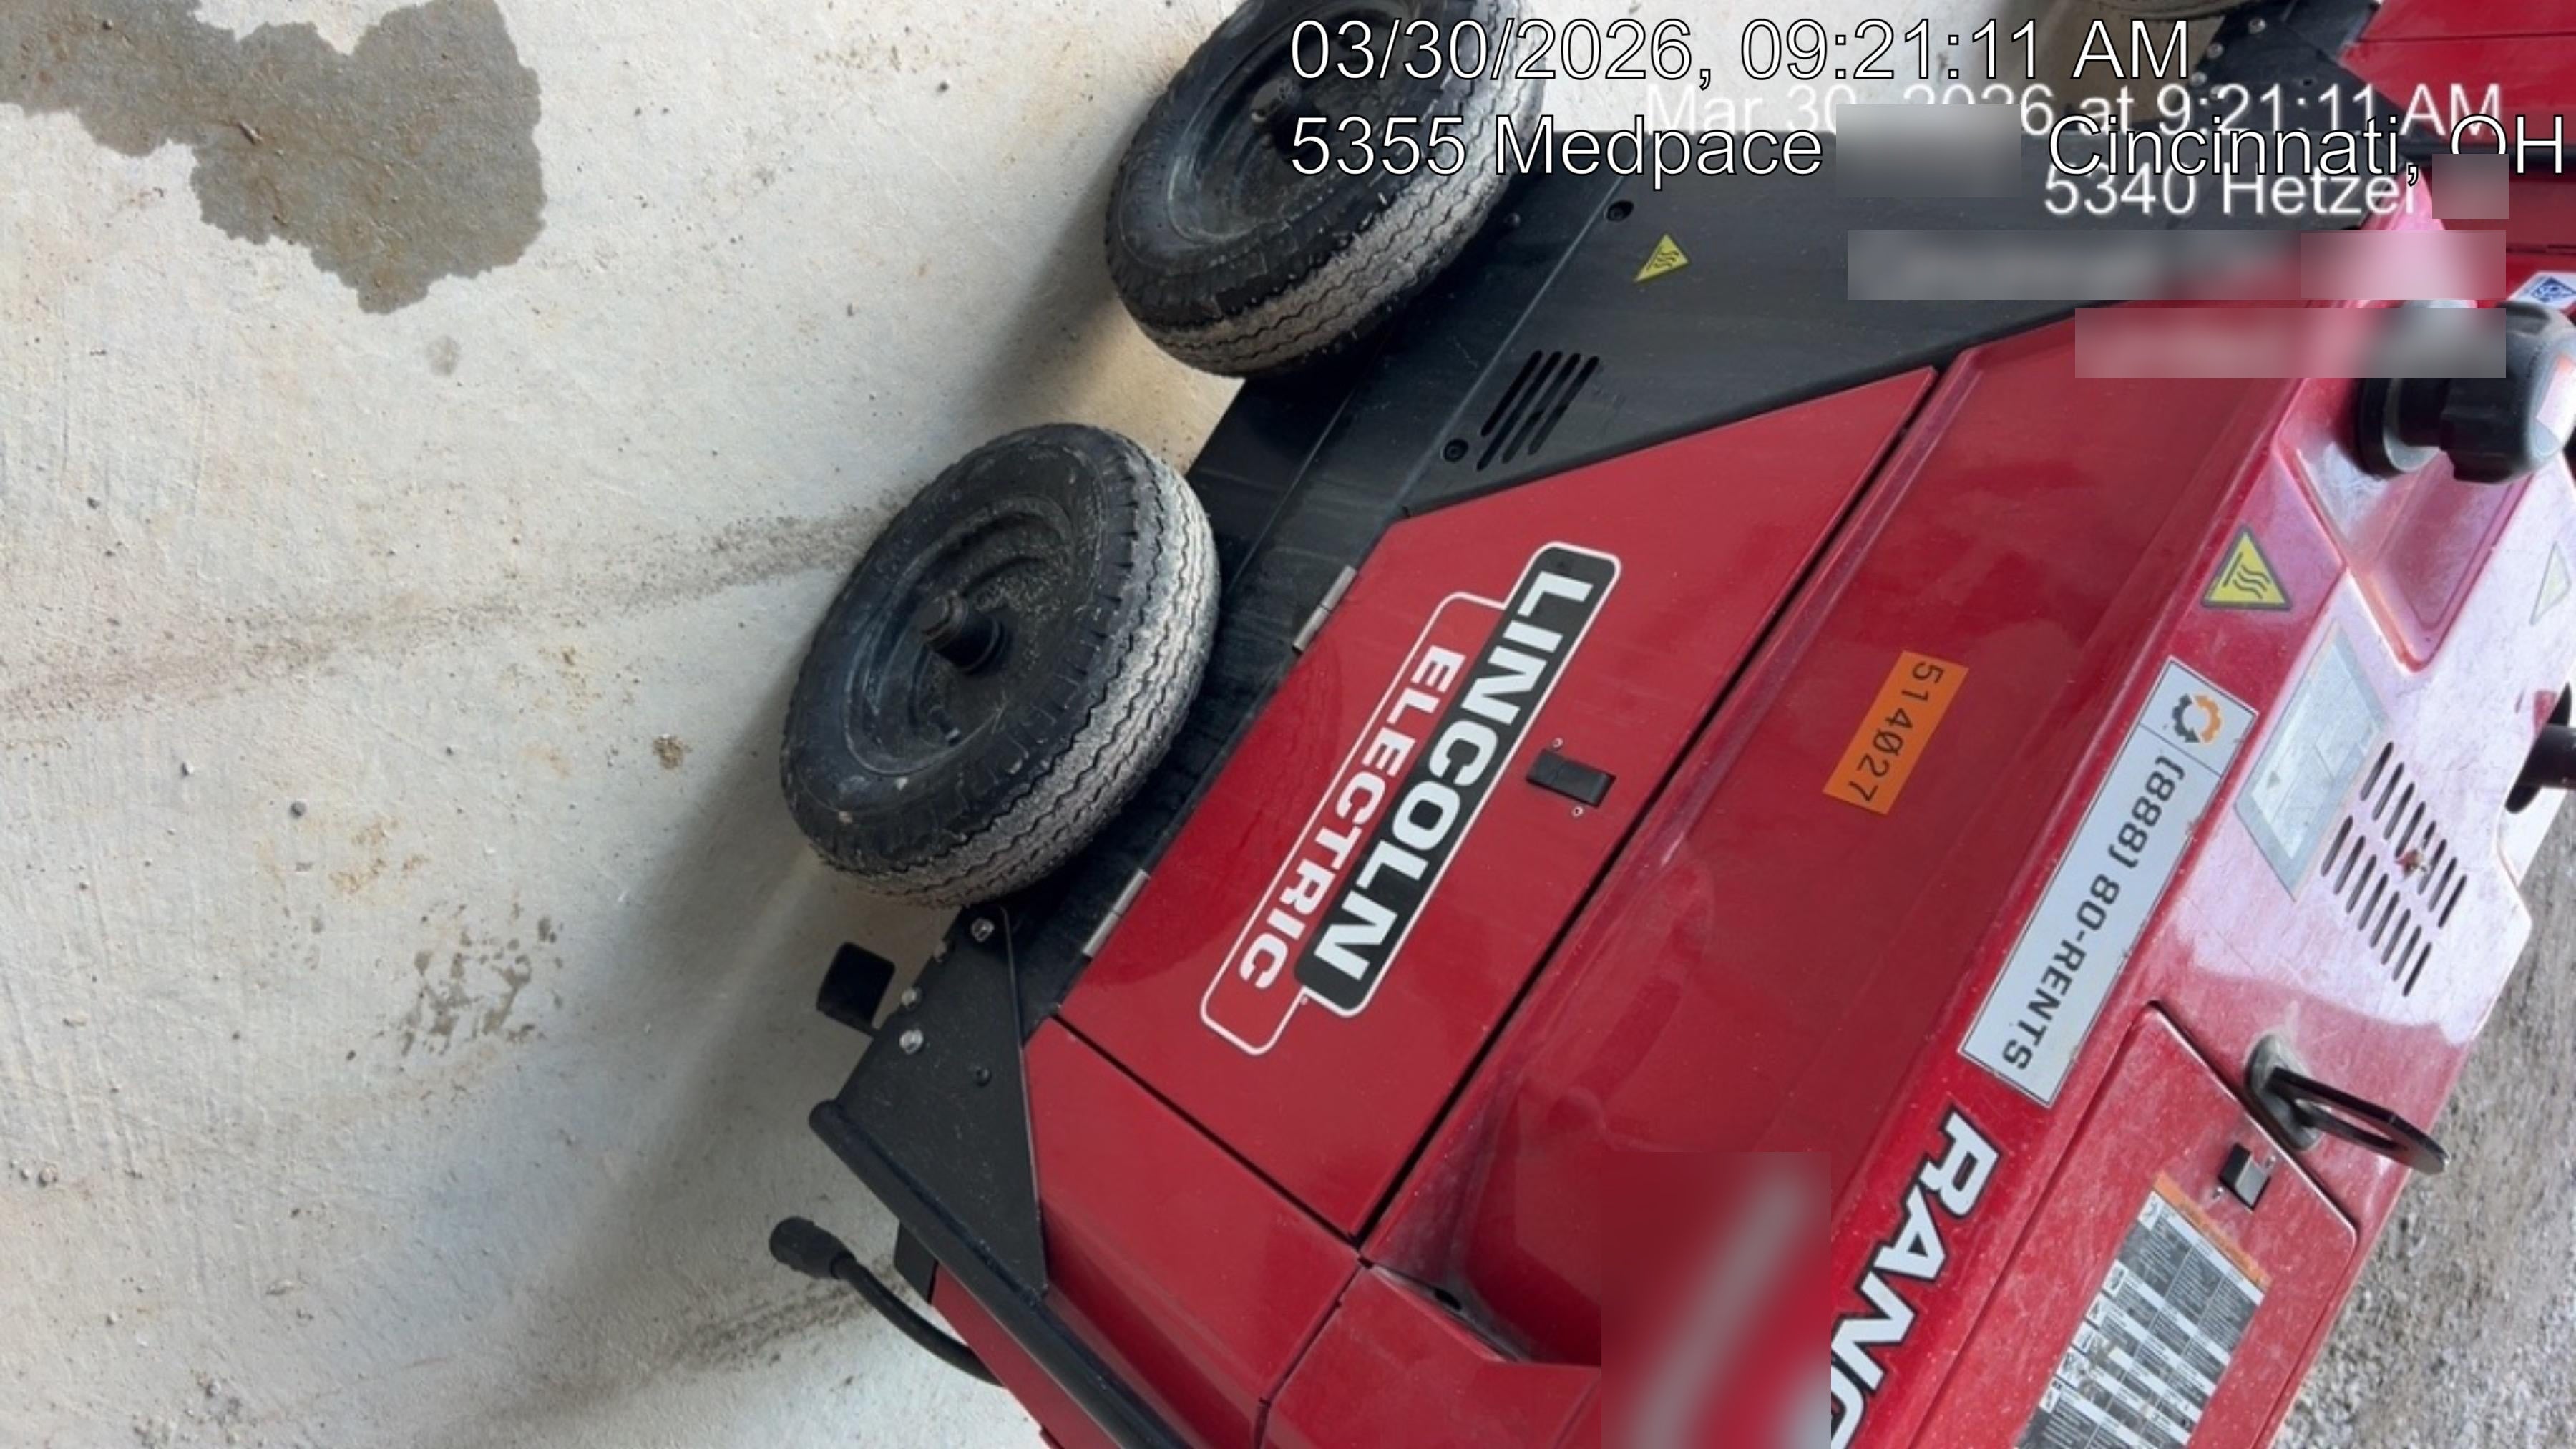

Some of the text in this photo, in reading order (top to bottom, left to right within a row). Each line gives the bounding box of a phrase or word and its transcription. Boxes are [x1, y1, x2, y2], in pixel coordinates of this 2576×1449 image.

[1238, 645, 1466, 988] ELECTRIC
[1314, 570, 1594, 980] LINCOLN
[1848, 661, 1944, 801] 514027
[2002, 756, 2186, 1072] (888) 80-RENTS
